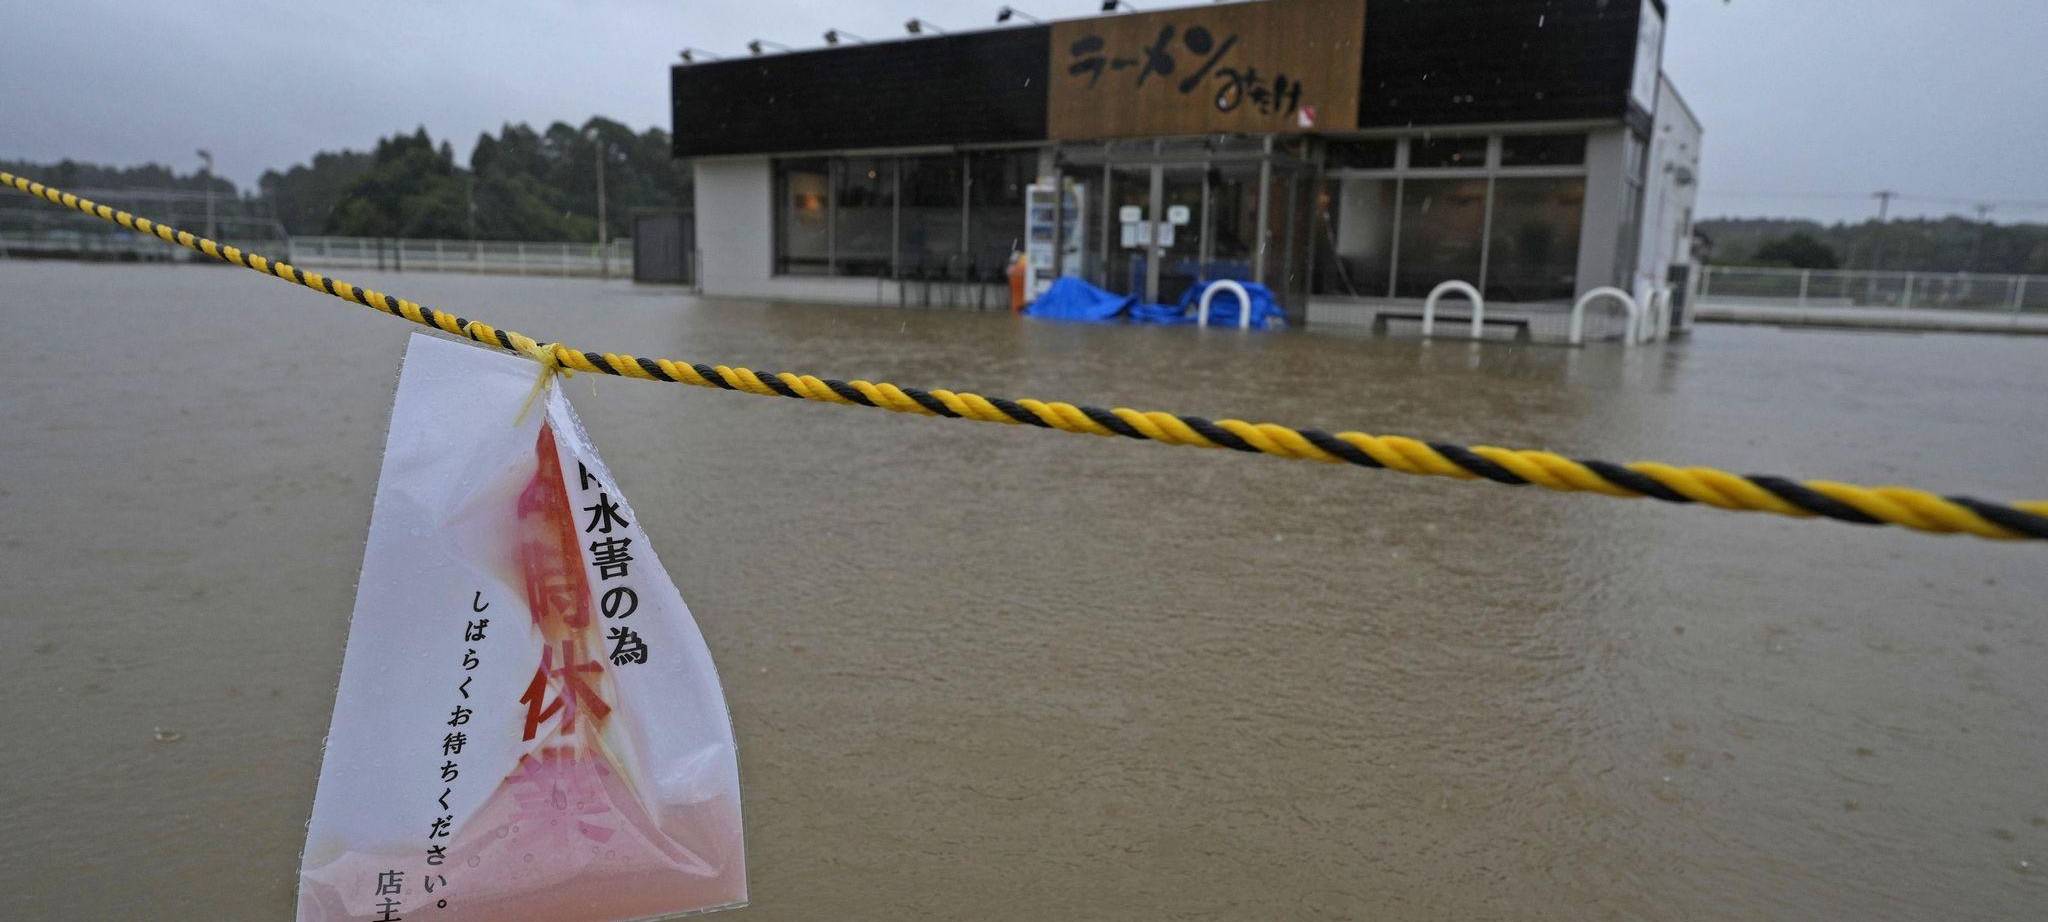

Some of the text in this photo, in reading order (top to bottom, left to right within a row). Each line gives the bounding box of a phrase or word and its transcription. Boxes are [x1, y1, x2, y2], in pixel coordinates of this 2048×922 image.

[1068, 25, 1239, 94] ラーメン
[423, 590, 490, 909] しばらくお待ちください。
[372, 869, 405, 922] 店主
